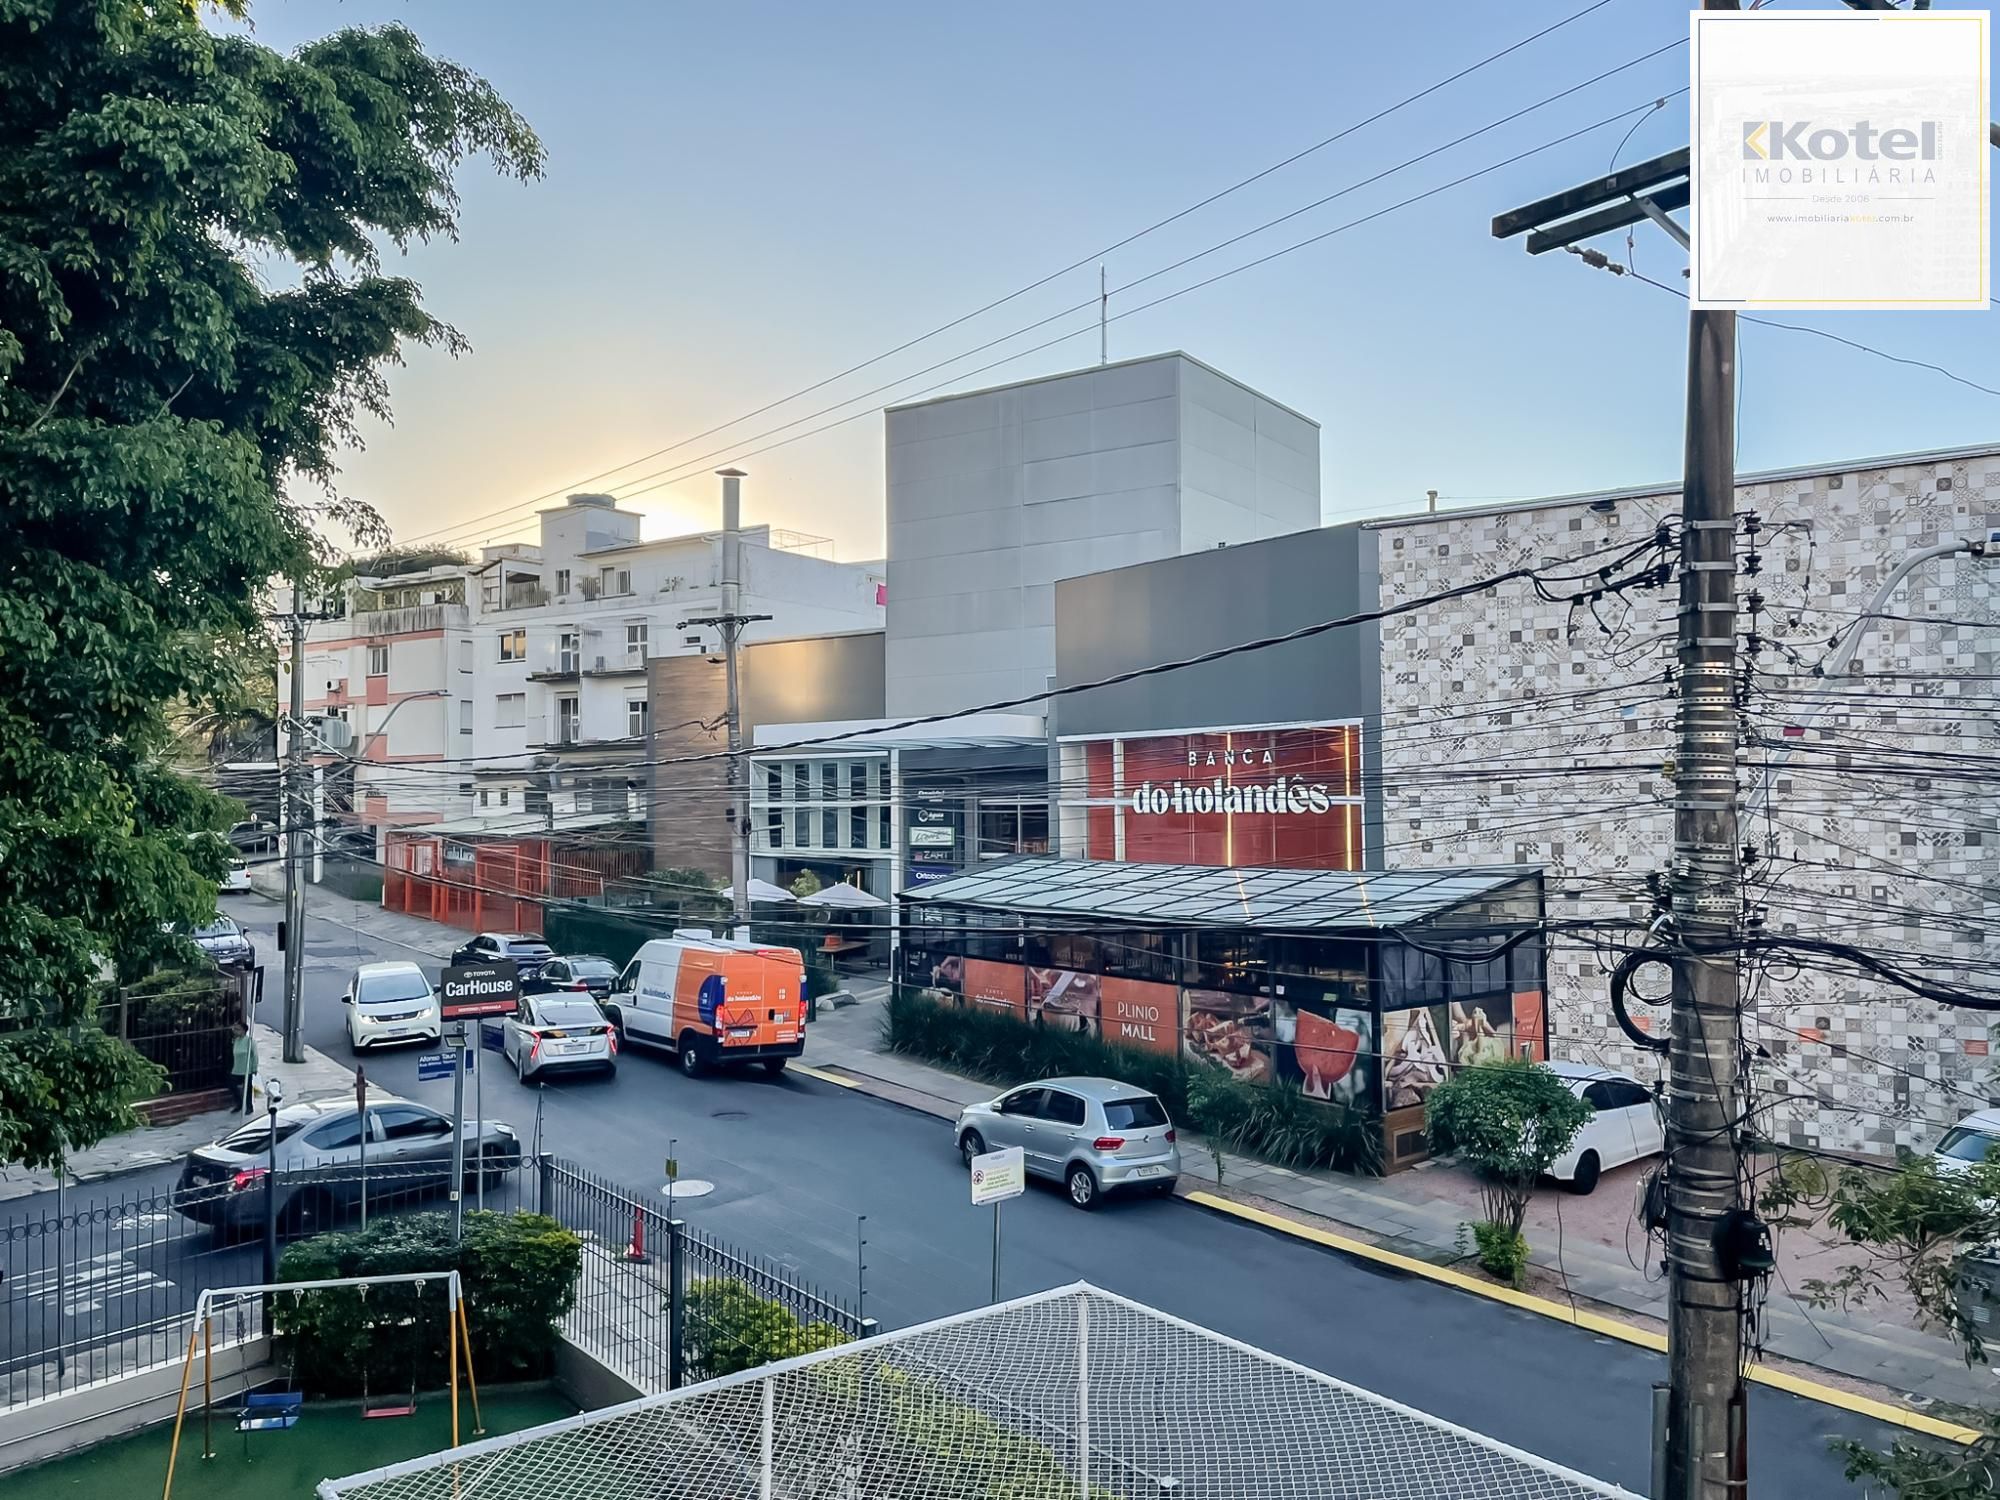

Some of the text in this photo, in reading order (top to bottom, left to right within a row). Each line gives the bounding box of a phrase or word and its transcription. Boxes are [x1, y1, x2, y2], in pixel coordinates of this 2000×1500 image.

[1188, 749, 1273, 767] BANCA
[1132, 774, 1331, 815] do holandês
[445, 980, 513, 997] CarHouse
[1117, 1001, 1159, 1022] PLINIO
[1121, 1022, 1156, 1041] MALL
